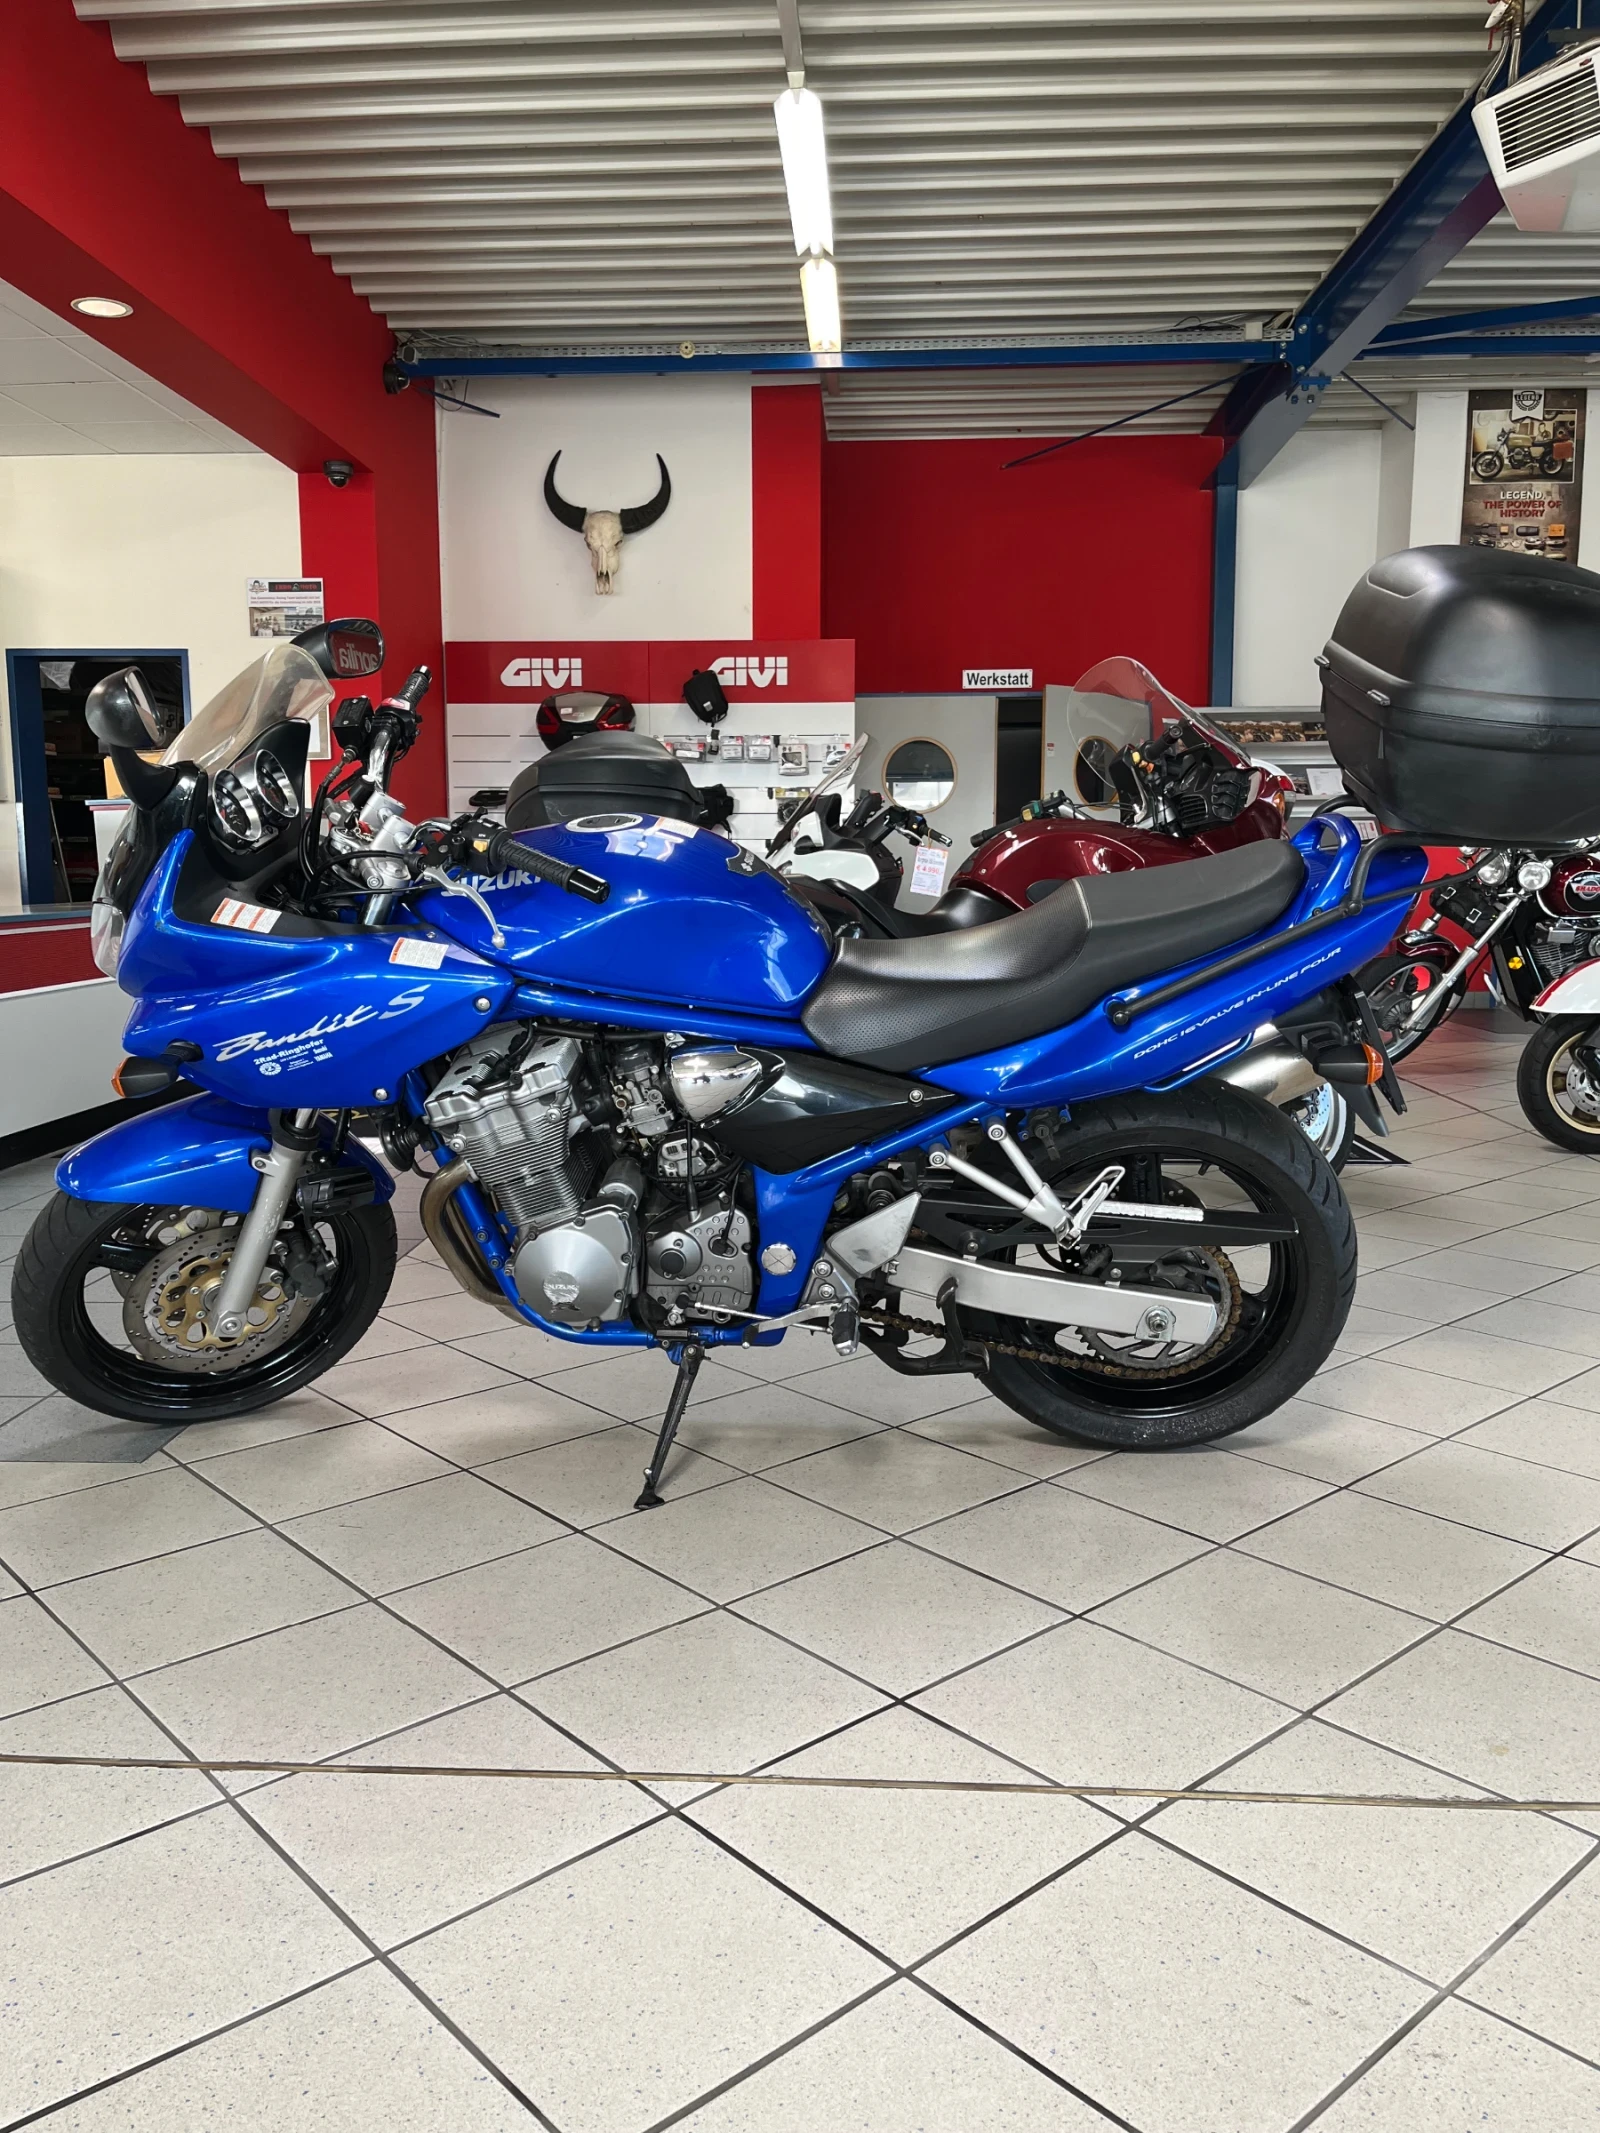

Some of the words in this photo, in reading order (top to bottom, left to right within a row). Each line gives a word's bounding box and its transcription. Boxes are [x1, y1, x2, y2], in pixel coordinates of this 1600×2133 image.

[1483, 501, 1504, 509] THE
[1506, 500, 1545, 509] POWER
[1547, 500, 1562, 509] OF
[1500, 509, 1546, 518] HISTORY
[500, 658, 582, 689] GIVI
[966, 672, 1029, 686] Werkstatt
[1134, 1034, 1178, 1060] DOHC
[1246, 970, 1299, 1003] IN-LINE
[1300, 946, 1342, 975] FOUR
[212, 1004, 378, 1062] Bandit
[378, 983, 431, 1020] S
[253, 1038, 324, 1065] 2Rad-Ringhofer
